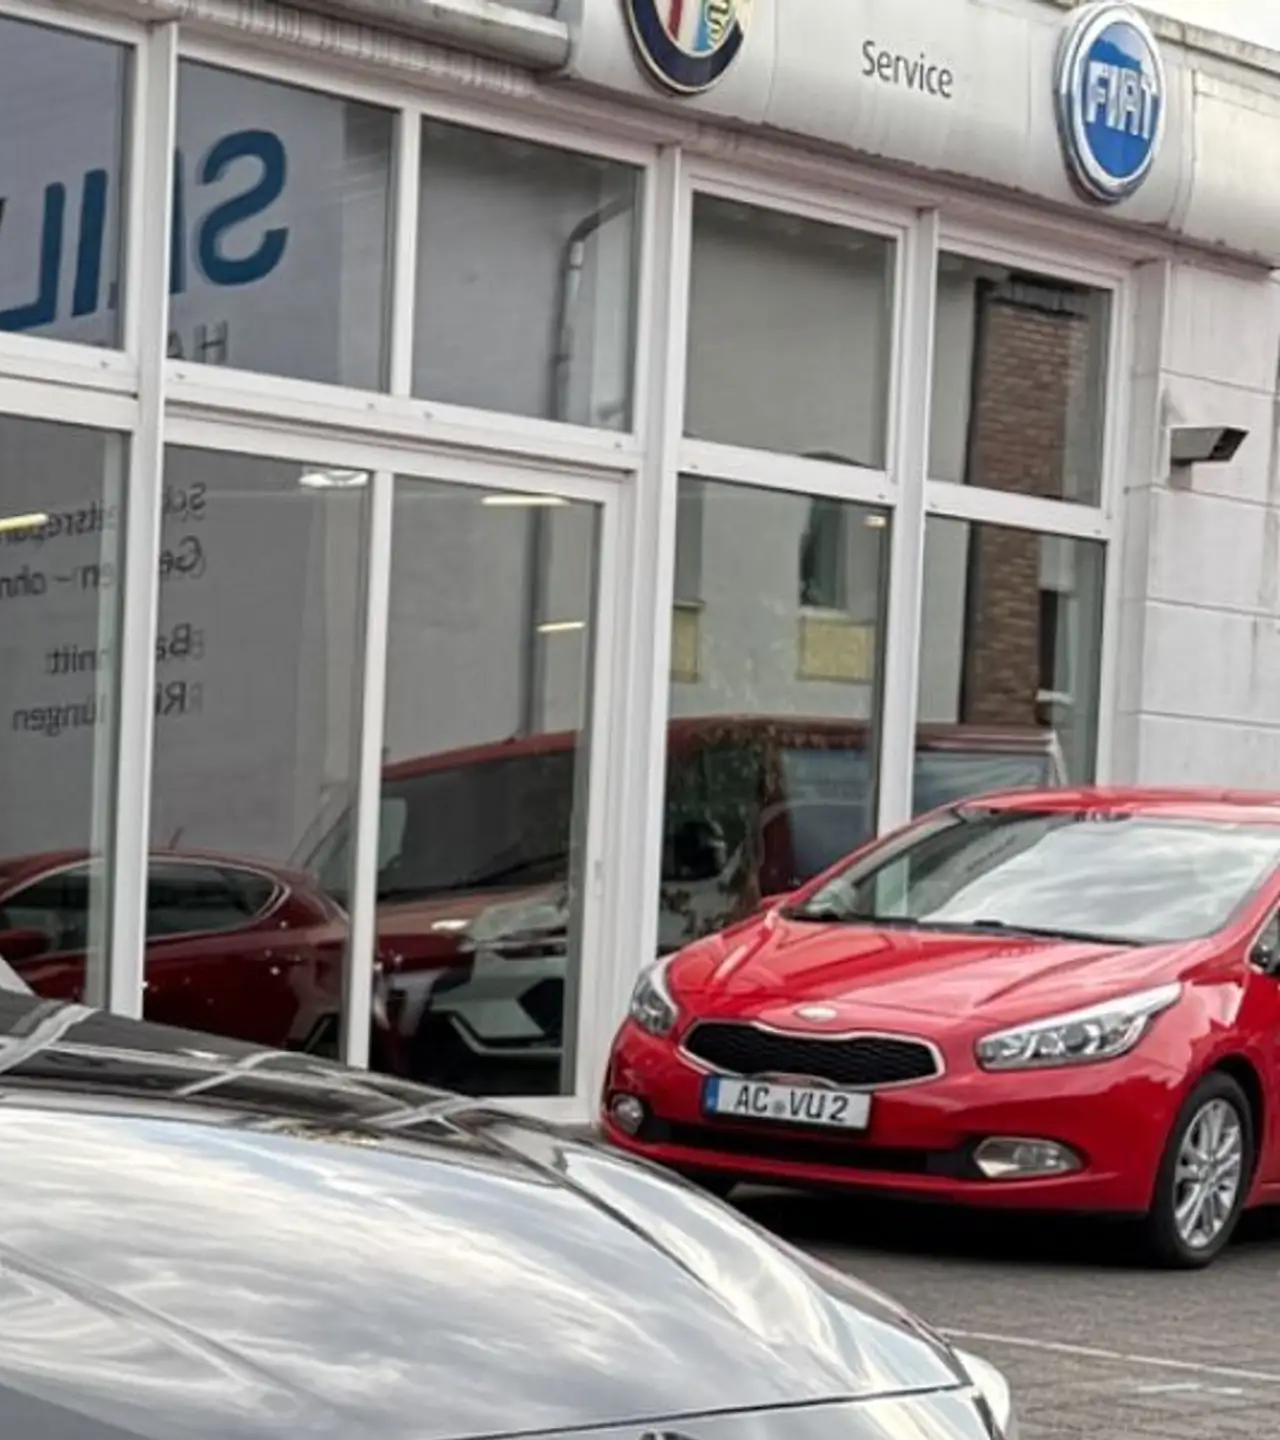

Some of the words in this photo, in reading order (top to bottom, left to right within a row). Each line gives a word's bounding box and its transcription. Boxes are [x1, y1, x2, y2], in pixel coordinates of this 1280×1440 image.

[860, 40, 954, 99] Service
[1085, 61, 1158, 139] FIAT
[734, 1085, 771, 1114] AC
[790, 1090, 826, 1120] VU
